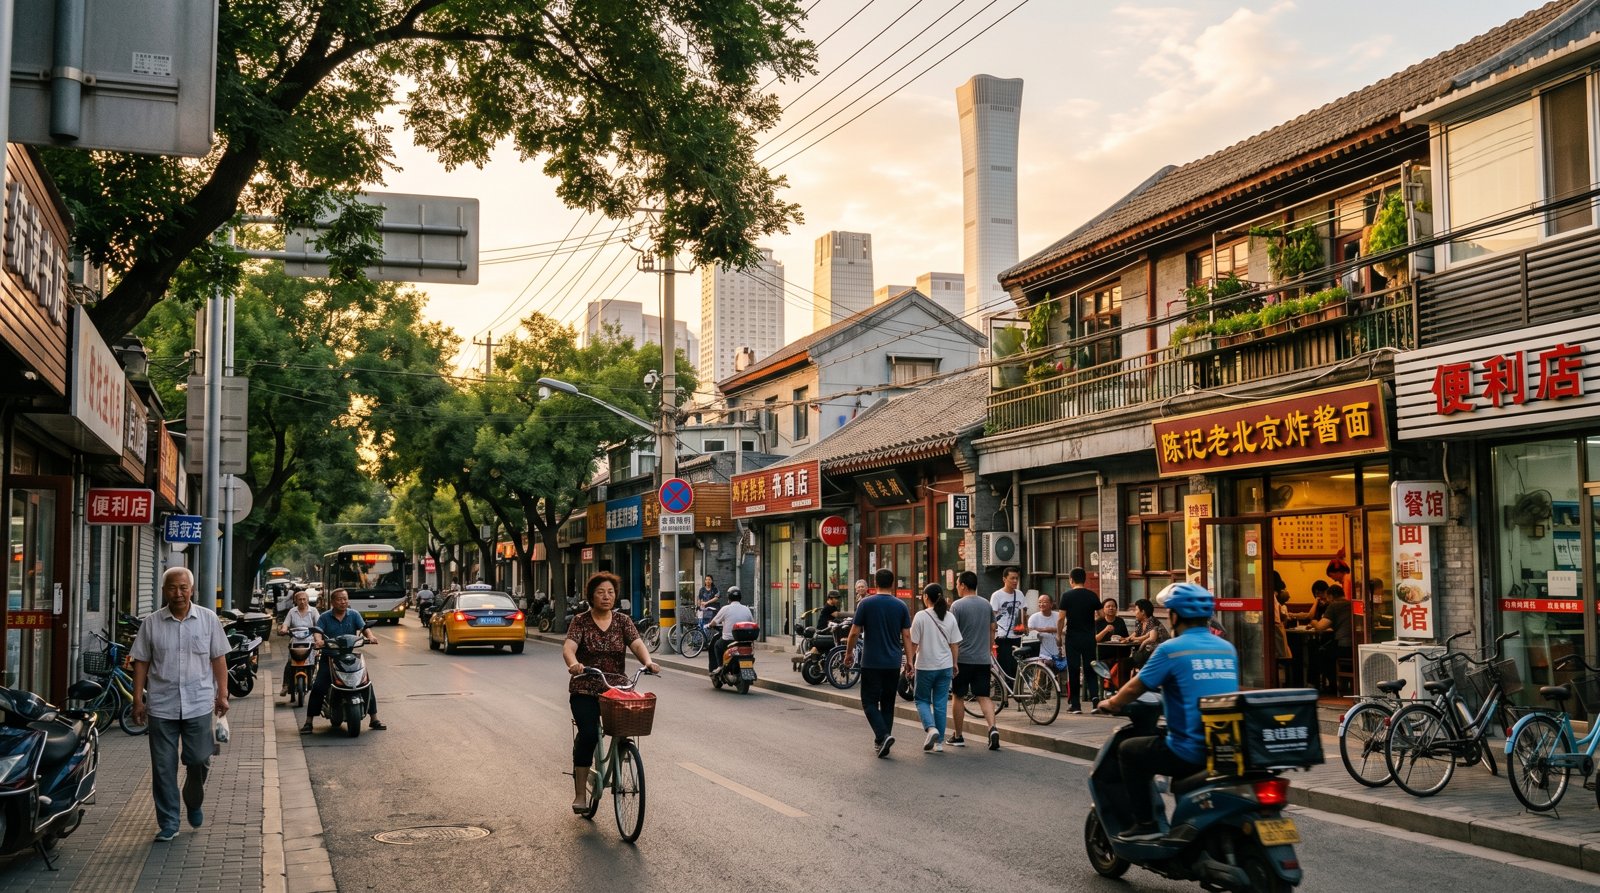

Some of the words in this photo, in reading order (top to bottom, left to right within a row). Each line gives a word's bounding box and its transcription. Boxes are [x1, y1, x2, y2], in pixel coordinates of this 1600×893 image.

[1432, 343, 1587, 416] 便利店
[1161, 401, 1373, 464] 陈记老北京炸酱面
[91, 495, 148, 517] 便利店
[1404, 490, 1444, 517] 餐馆
